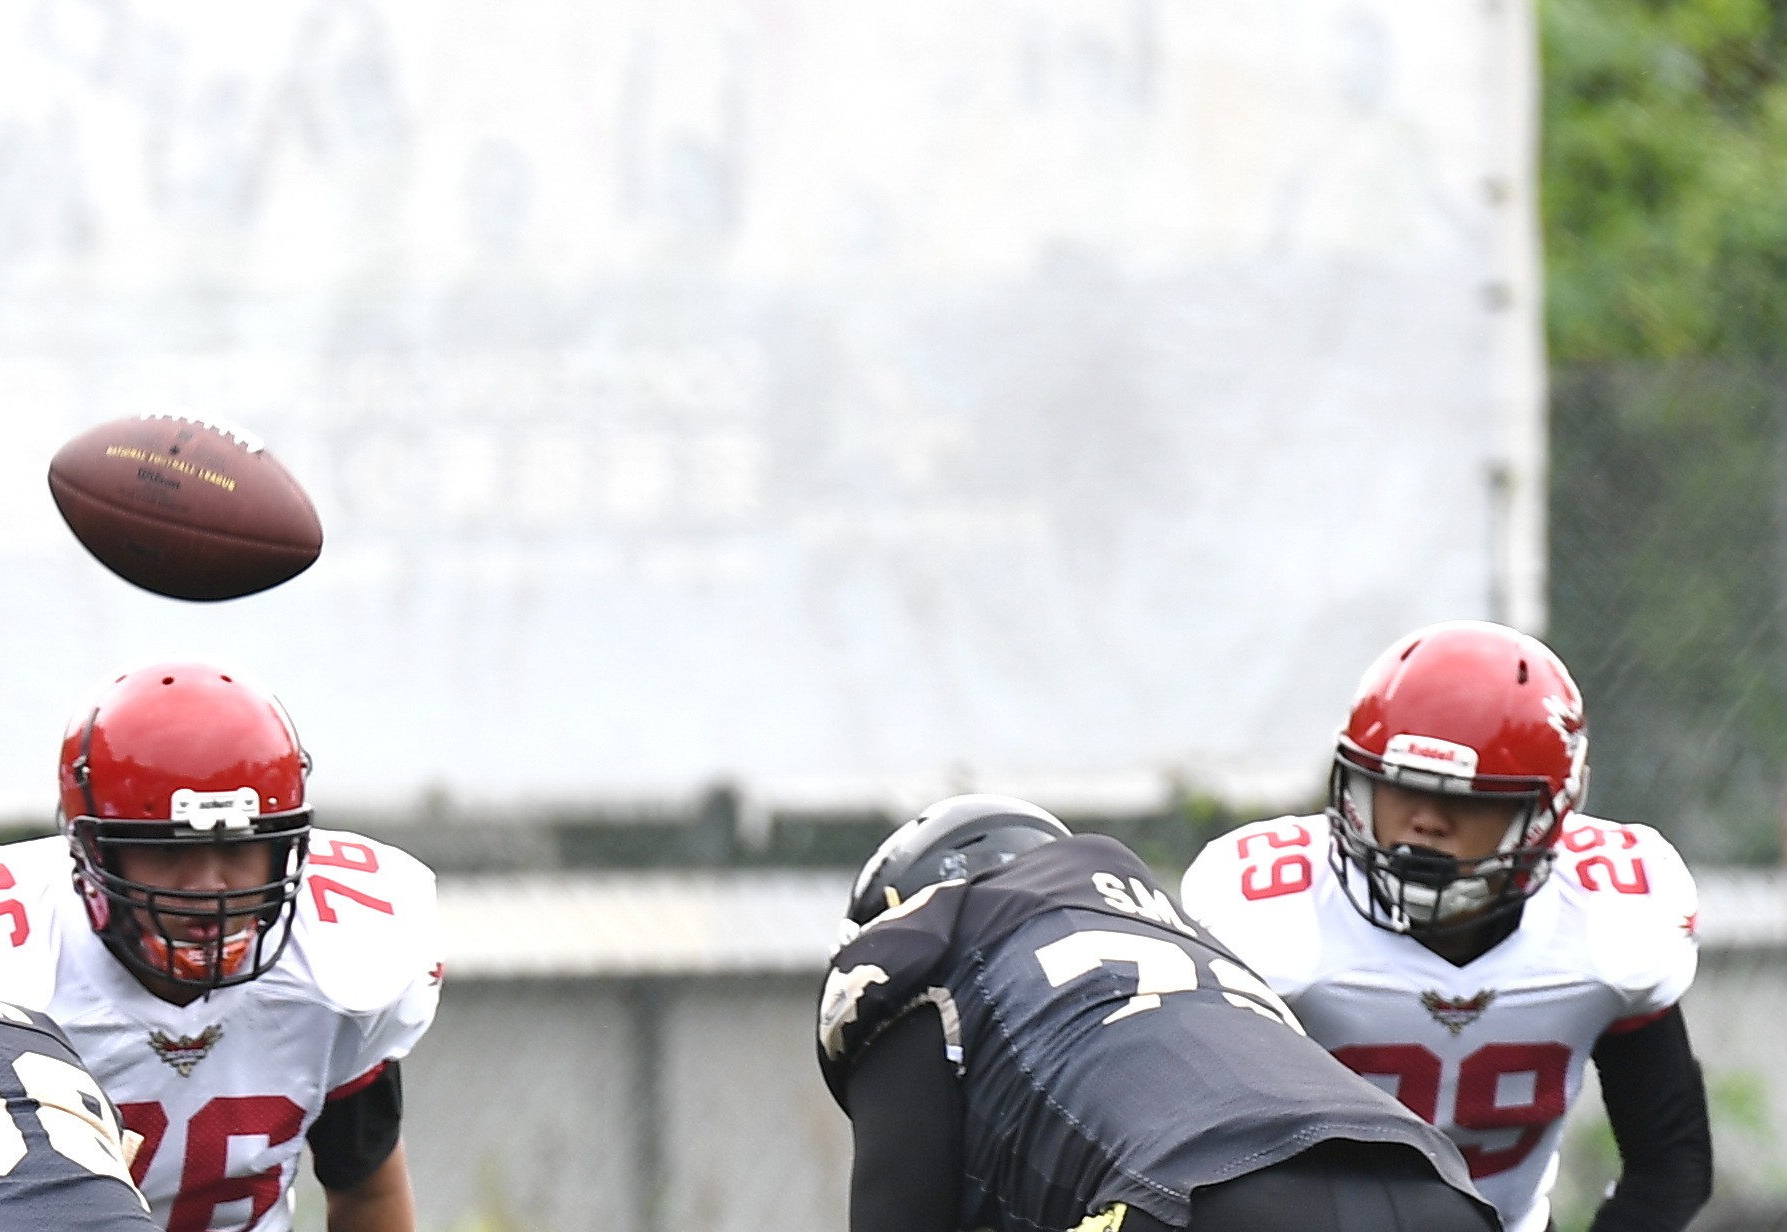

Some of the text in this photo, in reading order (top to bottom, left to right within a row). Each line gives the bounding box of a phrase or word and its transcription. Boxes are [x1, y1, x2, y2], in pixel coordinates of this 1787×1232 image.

[198, 467, 237, 492] LEAGUE
[307, 839, 395, 924] 76
[1236, 823, 1314, 902] 29
[1556, 825, 1651, 896] 29
